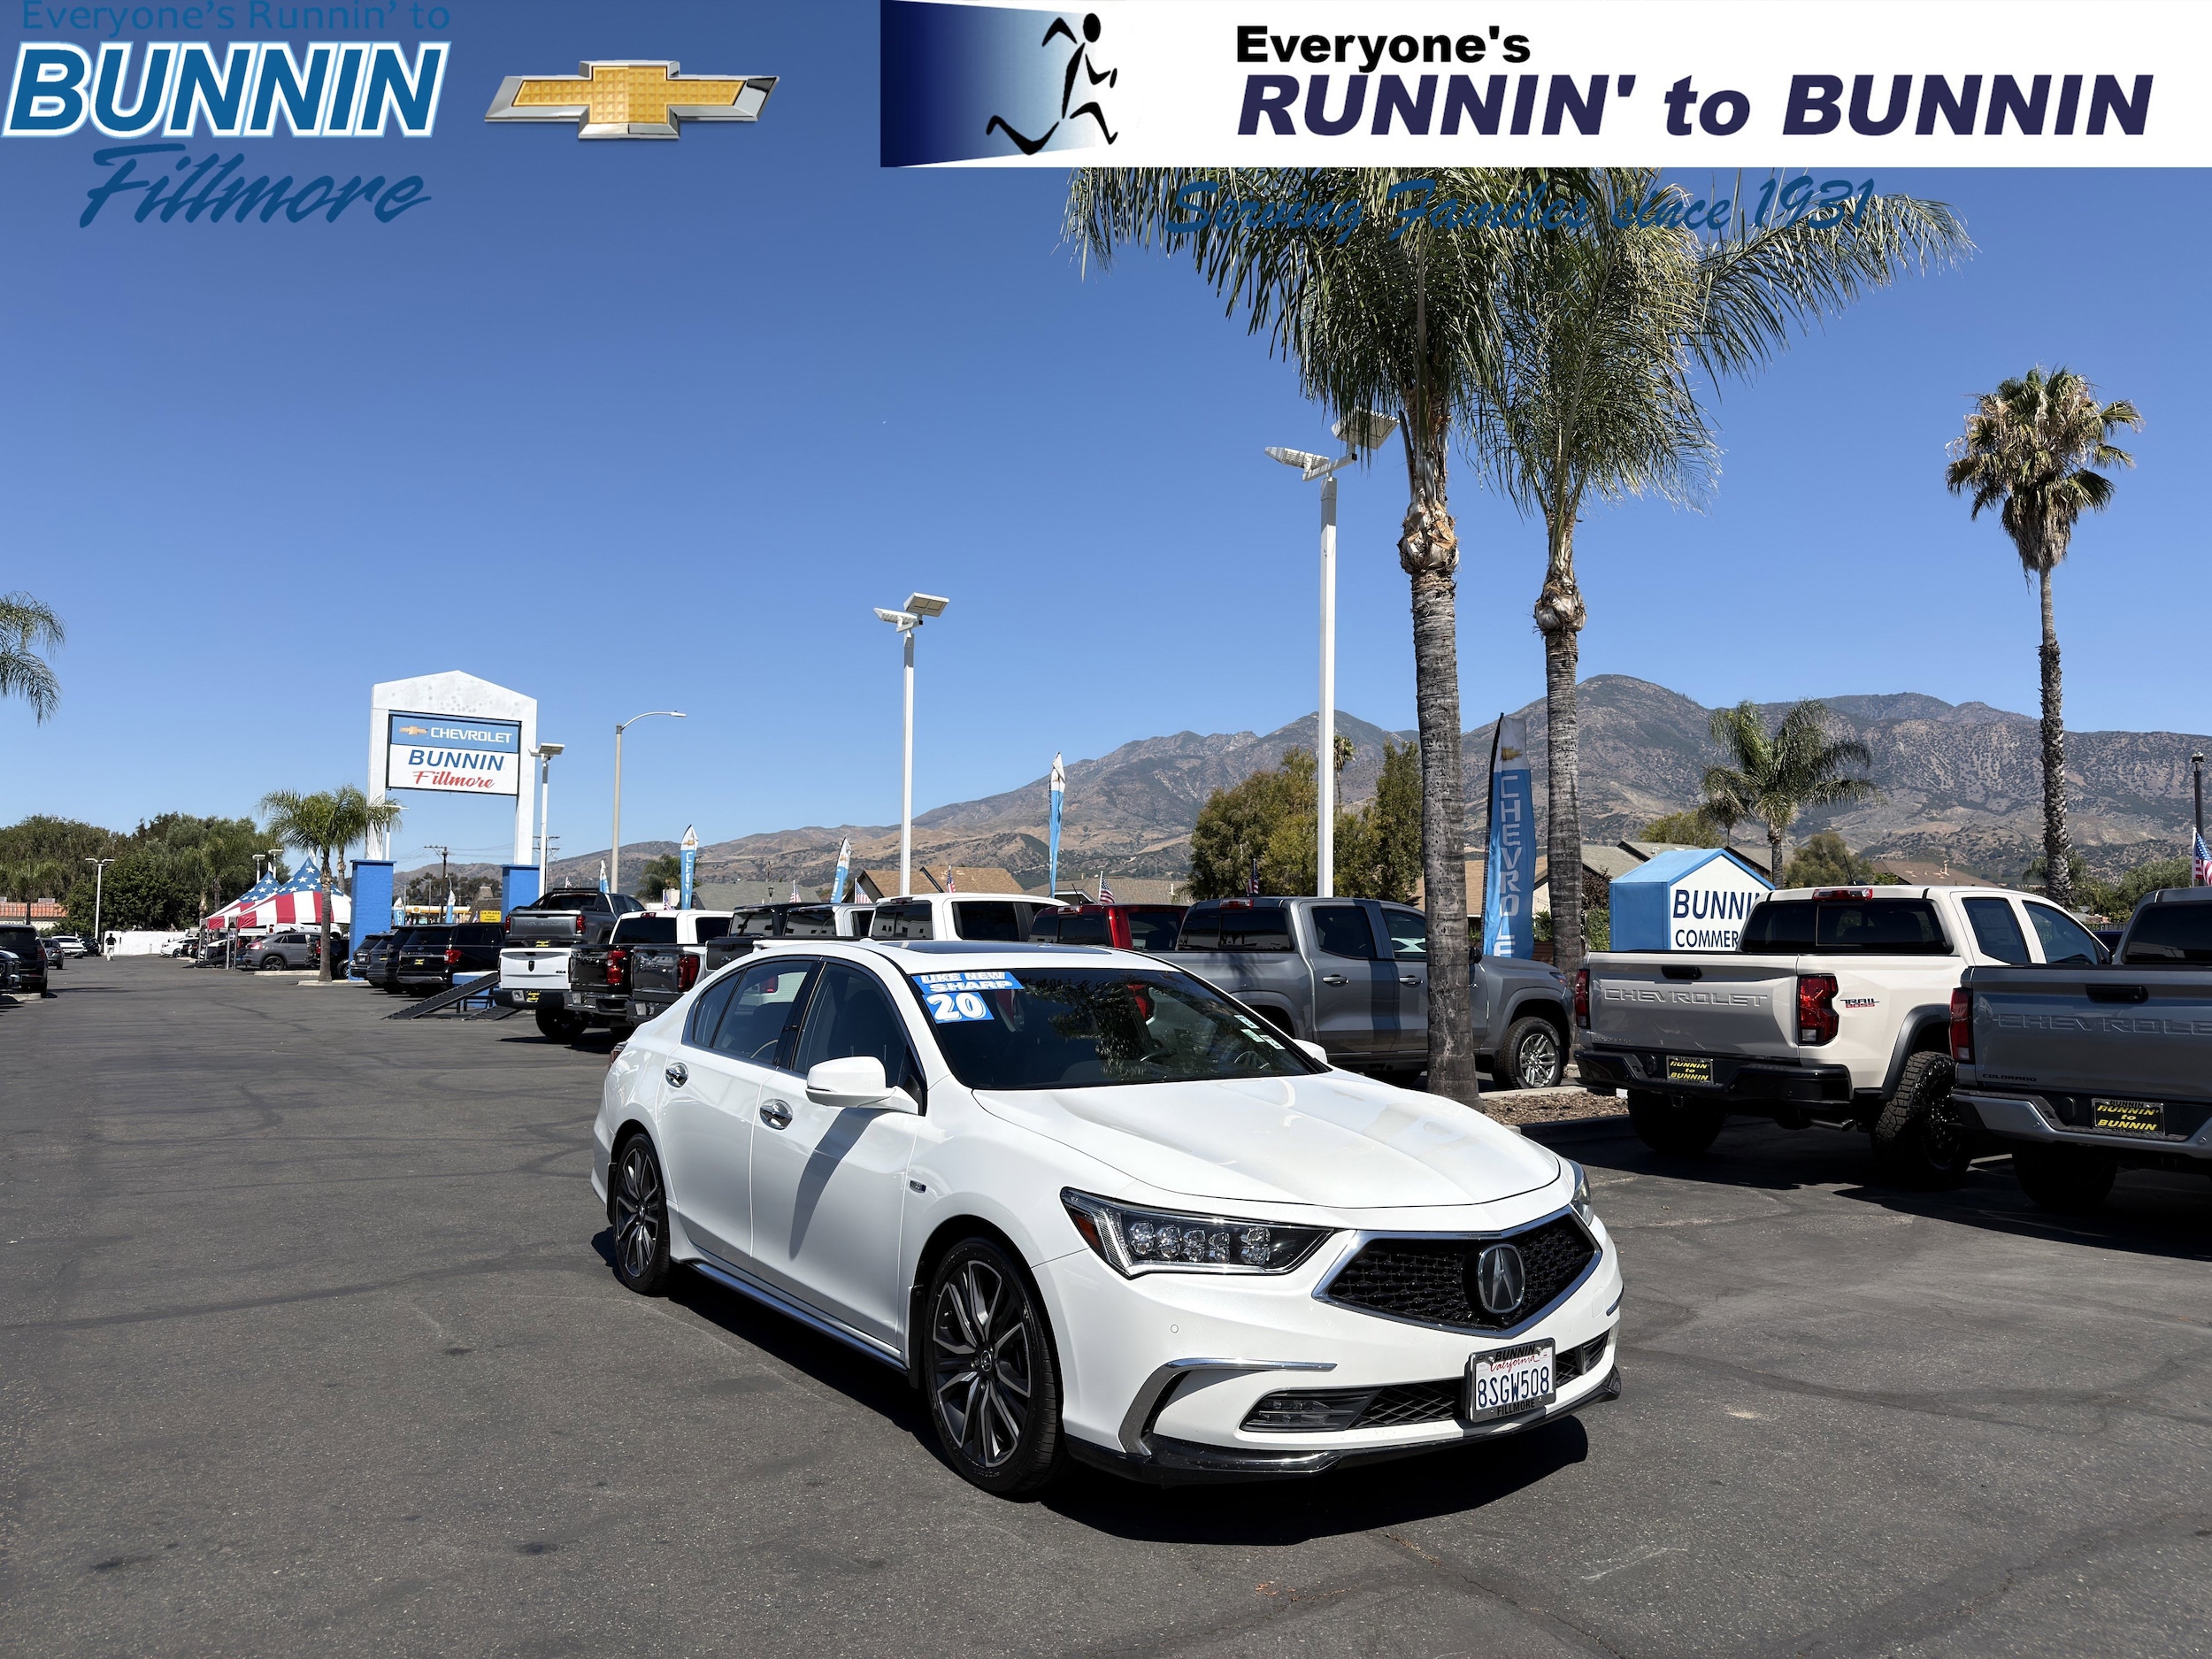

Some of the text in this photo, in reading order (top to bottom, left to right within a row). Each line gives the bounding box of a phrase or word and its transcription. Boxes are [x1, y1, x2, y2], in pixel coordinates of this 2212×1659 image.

[430, 726, 512, 743] CHEVROLET
[408, 749, 504, 771] BUNNIN
[412, 771, 495, 788] Fillmore
[964, 972, 1006, 980] NEW
[929, 980, 1013, 992] SHARP
[926, 992, 987, 1020] 20
[1604, 988, 1768, 1007] CHEVROLET
[1670, 1072, 1709, 1081] BUNNIN
[1982, 1073, 2037, 1082] COLORADO
[2098, 1119, 2157, 1131] BUNNIN
[1494, 1344, 1536, 1361] BUNNIN
[1489, 1355, 1540, 1372] California
[1478, 1366, 1549, 1408] 8SGW508
[1497, 1400, 1535, 1417] FILLMORE
